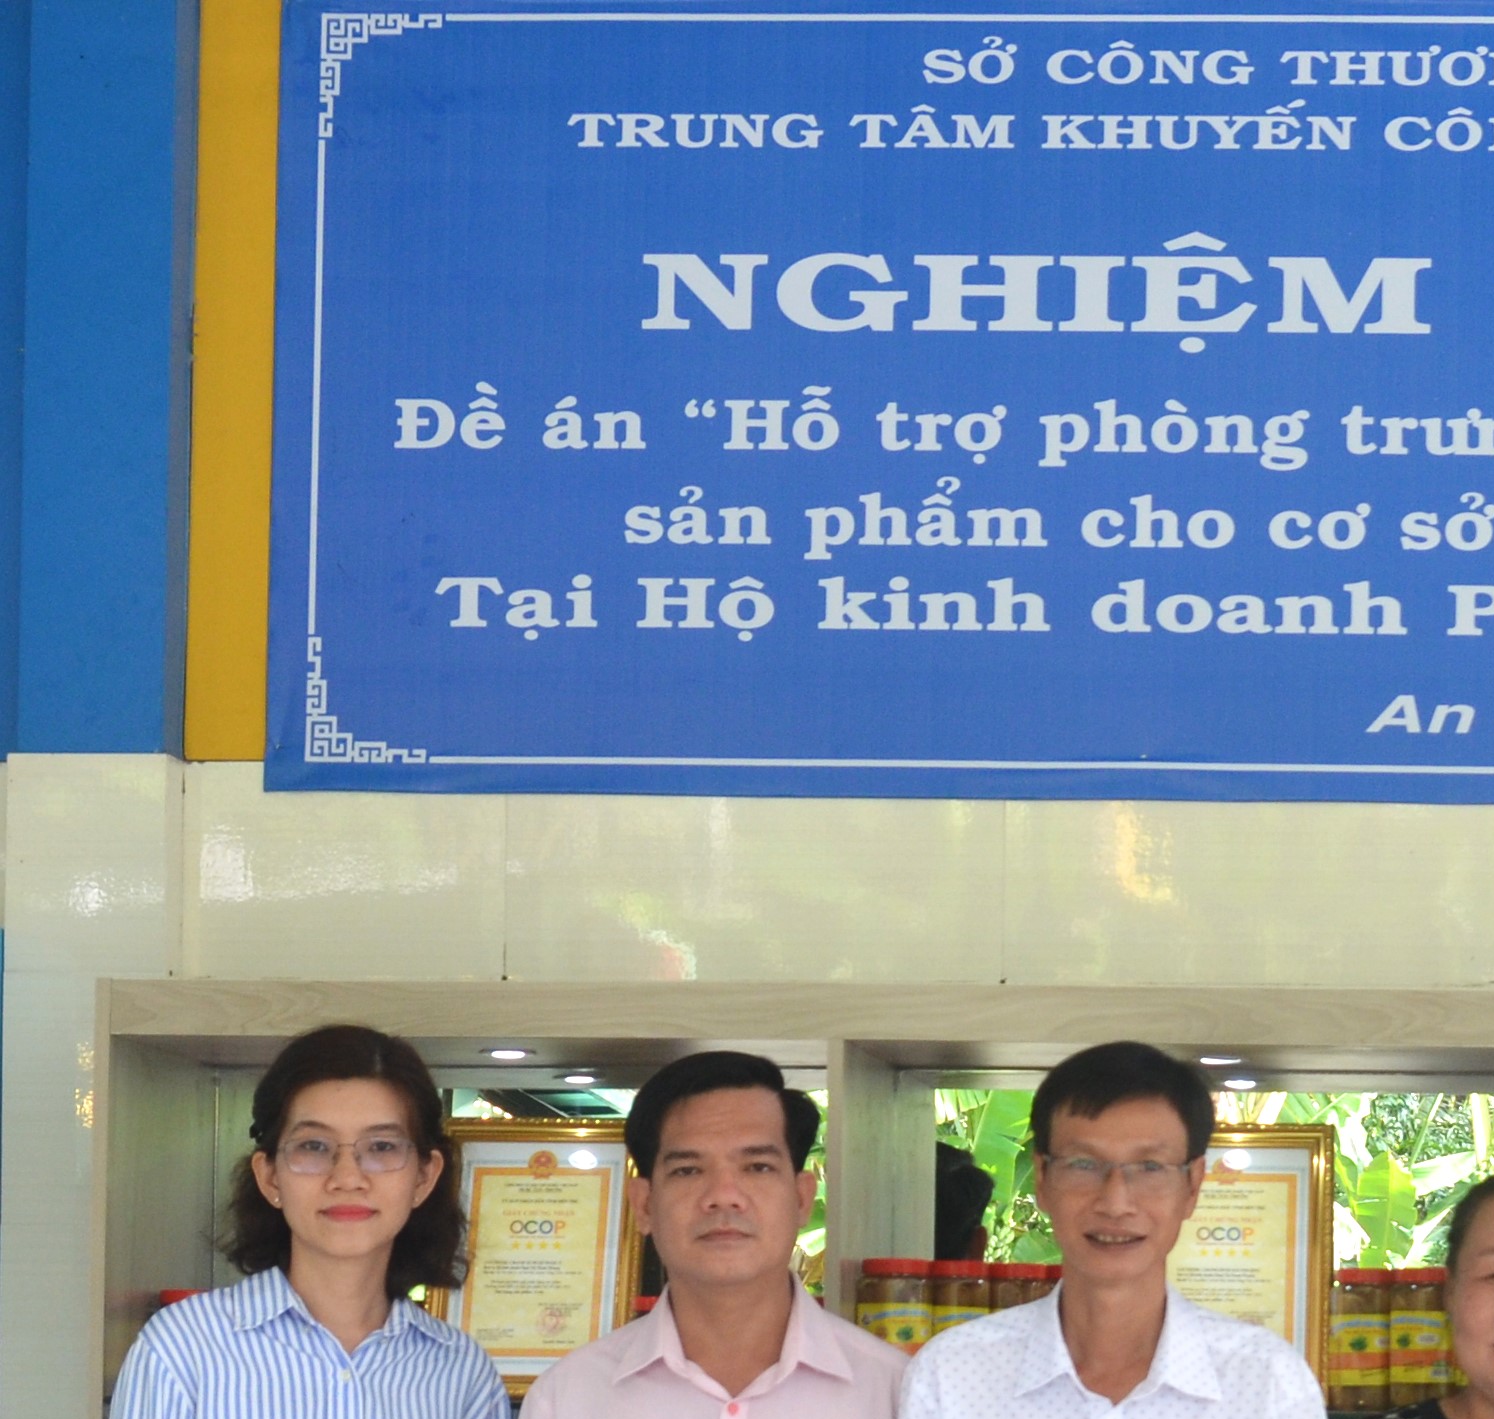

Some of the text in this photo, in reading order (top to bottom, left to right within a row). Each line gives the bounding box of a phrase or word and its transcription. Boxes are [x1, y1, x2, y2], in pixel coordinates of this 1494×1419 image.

[923, 36, 1018, 84] SỞ
[1046, 40, 1255, 85] CÔNG
[567, 113, 824, 148] TRUNG
[849, 104, 1015, 149] TÂM
[1041, 99, 1357, 150] KHUYẾN
[641, 231, 1432, 354] NGHIỆM
[394, 381, 506, 449] Đề
[542, 395, 646, 449] án
[876, 402, 1007, 465] trợ
[1038, 399, 1310, 471] phòng
[624, 485, 772, 545] sản
[804, 476, 1048, 560] phẩm
[1081, 494, 1235, 549] cho
[1268, 502, 1371, 550] cơ
[435, 574, 598, 641] Tại
[636, 576, 775, 642] Hộ
[818, 576, 1051, 632] kinh
[1091, 579, 1408, 635] doanh
[1366, 695, 1475, 734] An
[509, 1219, 566, 1235] OCOP
[1195, 1226, 1255, 1242] OCOP
